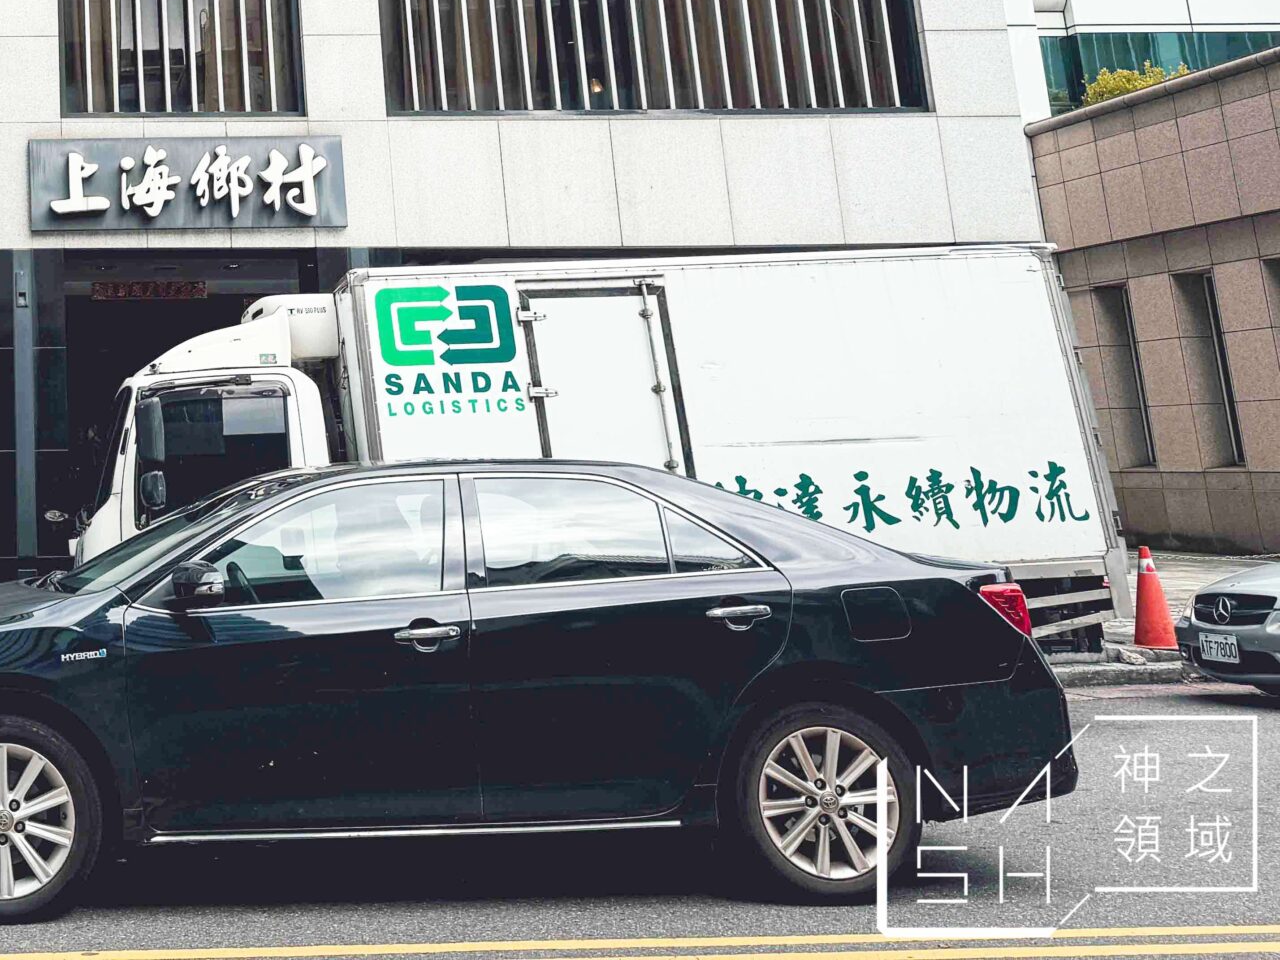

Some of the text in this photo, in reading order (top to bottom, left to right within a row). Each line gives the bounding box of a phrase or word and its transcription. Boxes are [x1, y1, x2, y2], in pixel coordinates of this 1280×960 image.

[49, 143, 328, 218] 上海鄉村
[384, 370, 521, 396] SANDA
[387, 397, 526, 417] LOGISTICS
[716, 460, 1090, 534] 達永續物流
[61, 650, 100, 661] HYBRID
